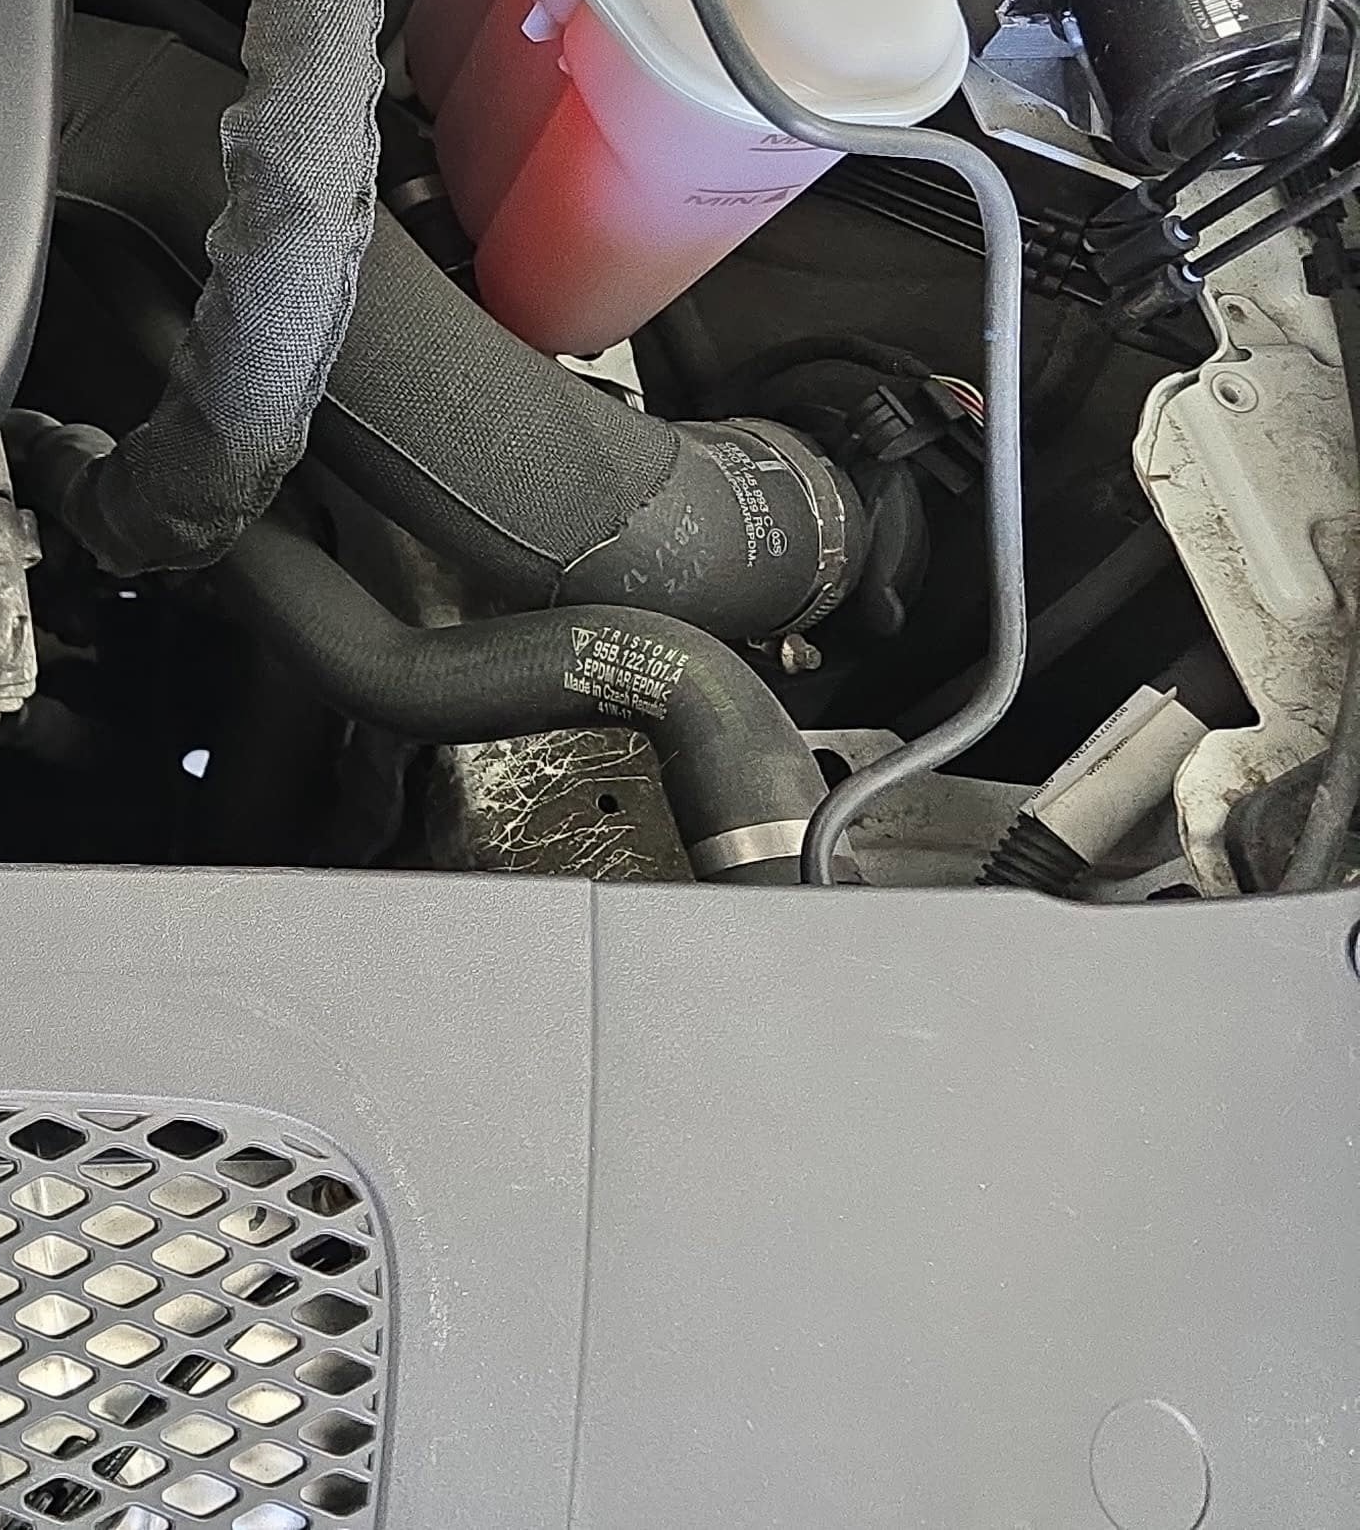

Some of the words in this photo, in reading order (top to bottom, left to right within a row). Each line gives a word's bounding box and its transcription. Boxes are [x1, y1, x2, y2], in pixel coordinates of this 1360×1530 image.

[764, 515, 774, 528] C
[593, 640, 684, 685] 95B.122.101.A
[600, 626, 690, 668] TRISTONE
[564, 671, 592, 695] Made
